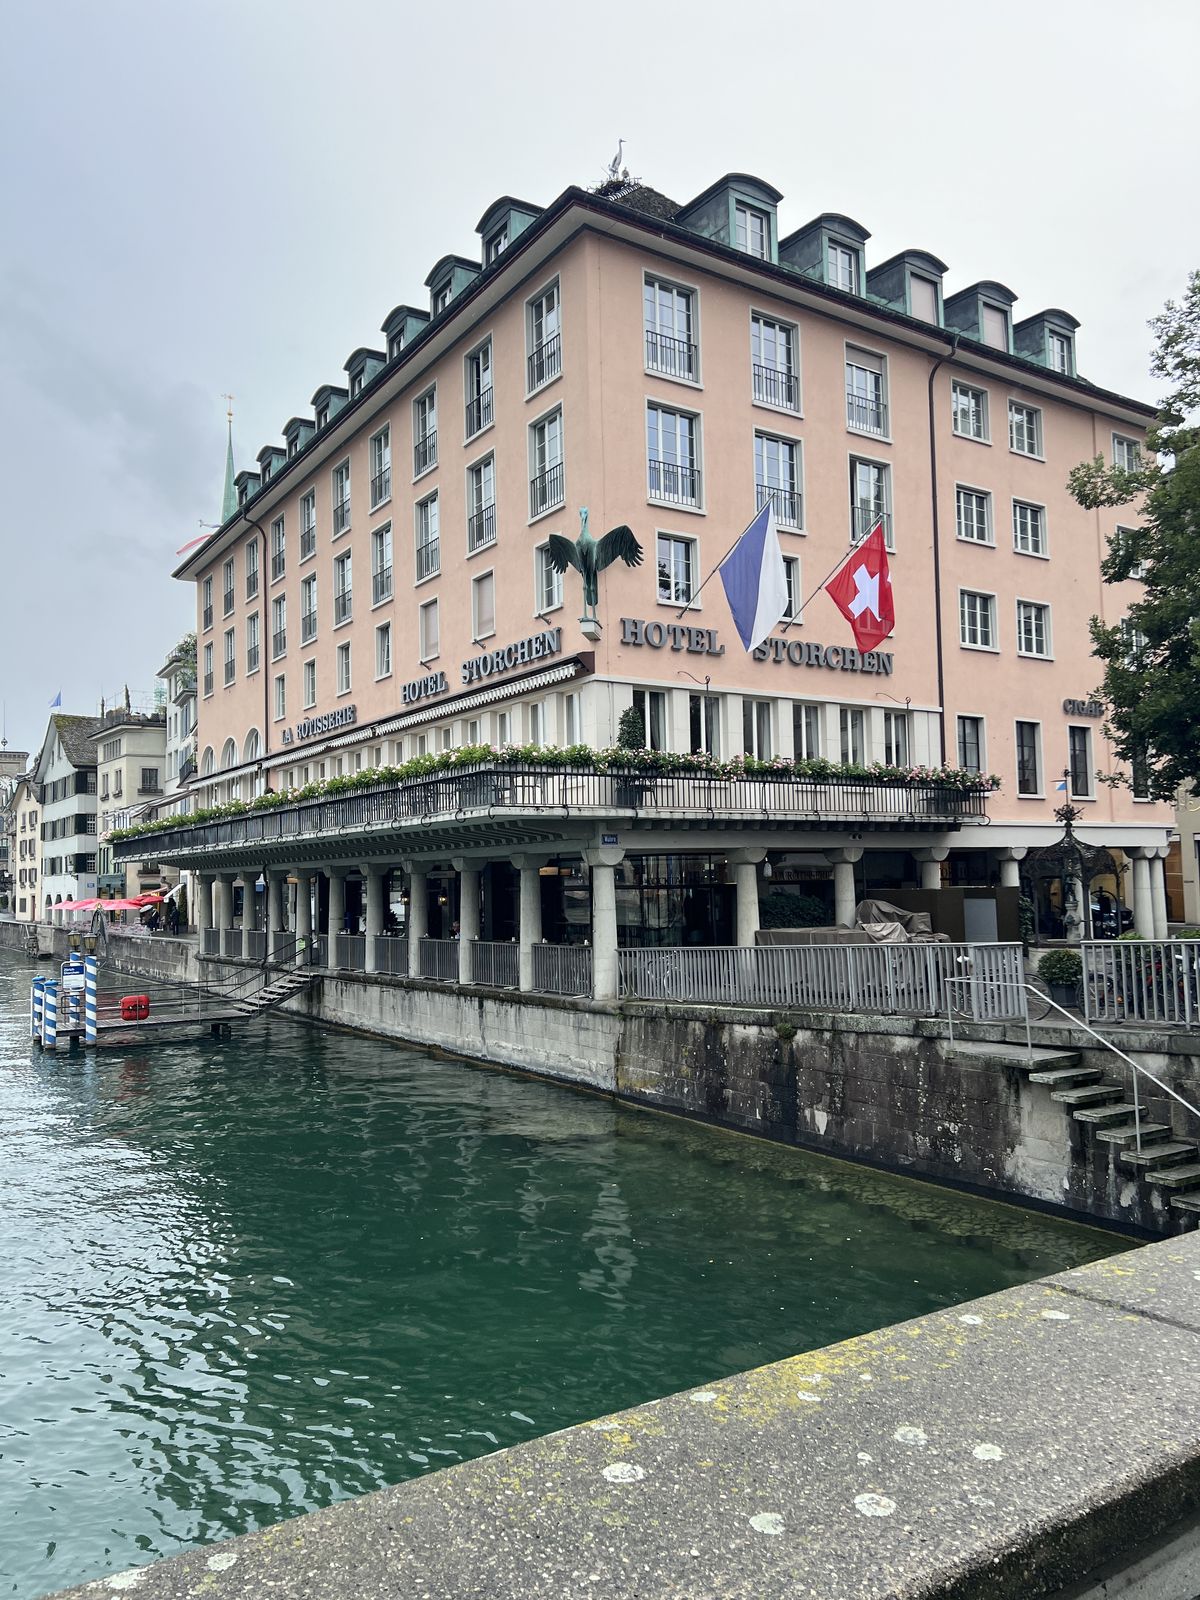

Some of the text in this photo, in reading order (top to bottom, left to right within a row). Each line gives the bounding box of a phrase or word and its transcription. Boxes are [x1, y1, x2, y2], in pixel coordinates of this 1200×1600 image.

[401, 627, 562, 704] HOTEL STORCHEN
[620, 617, 894, 675] HOTEL STORCHEN
